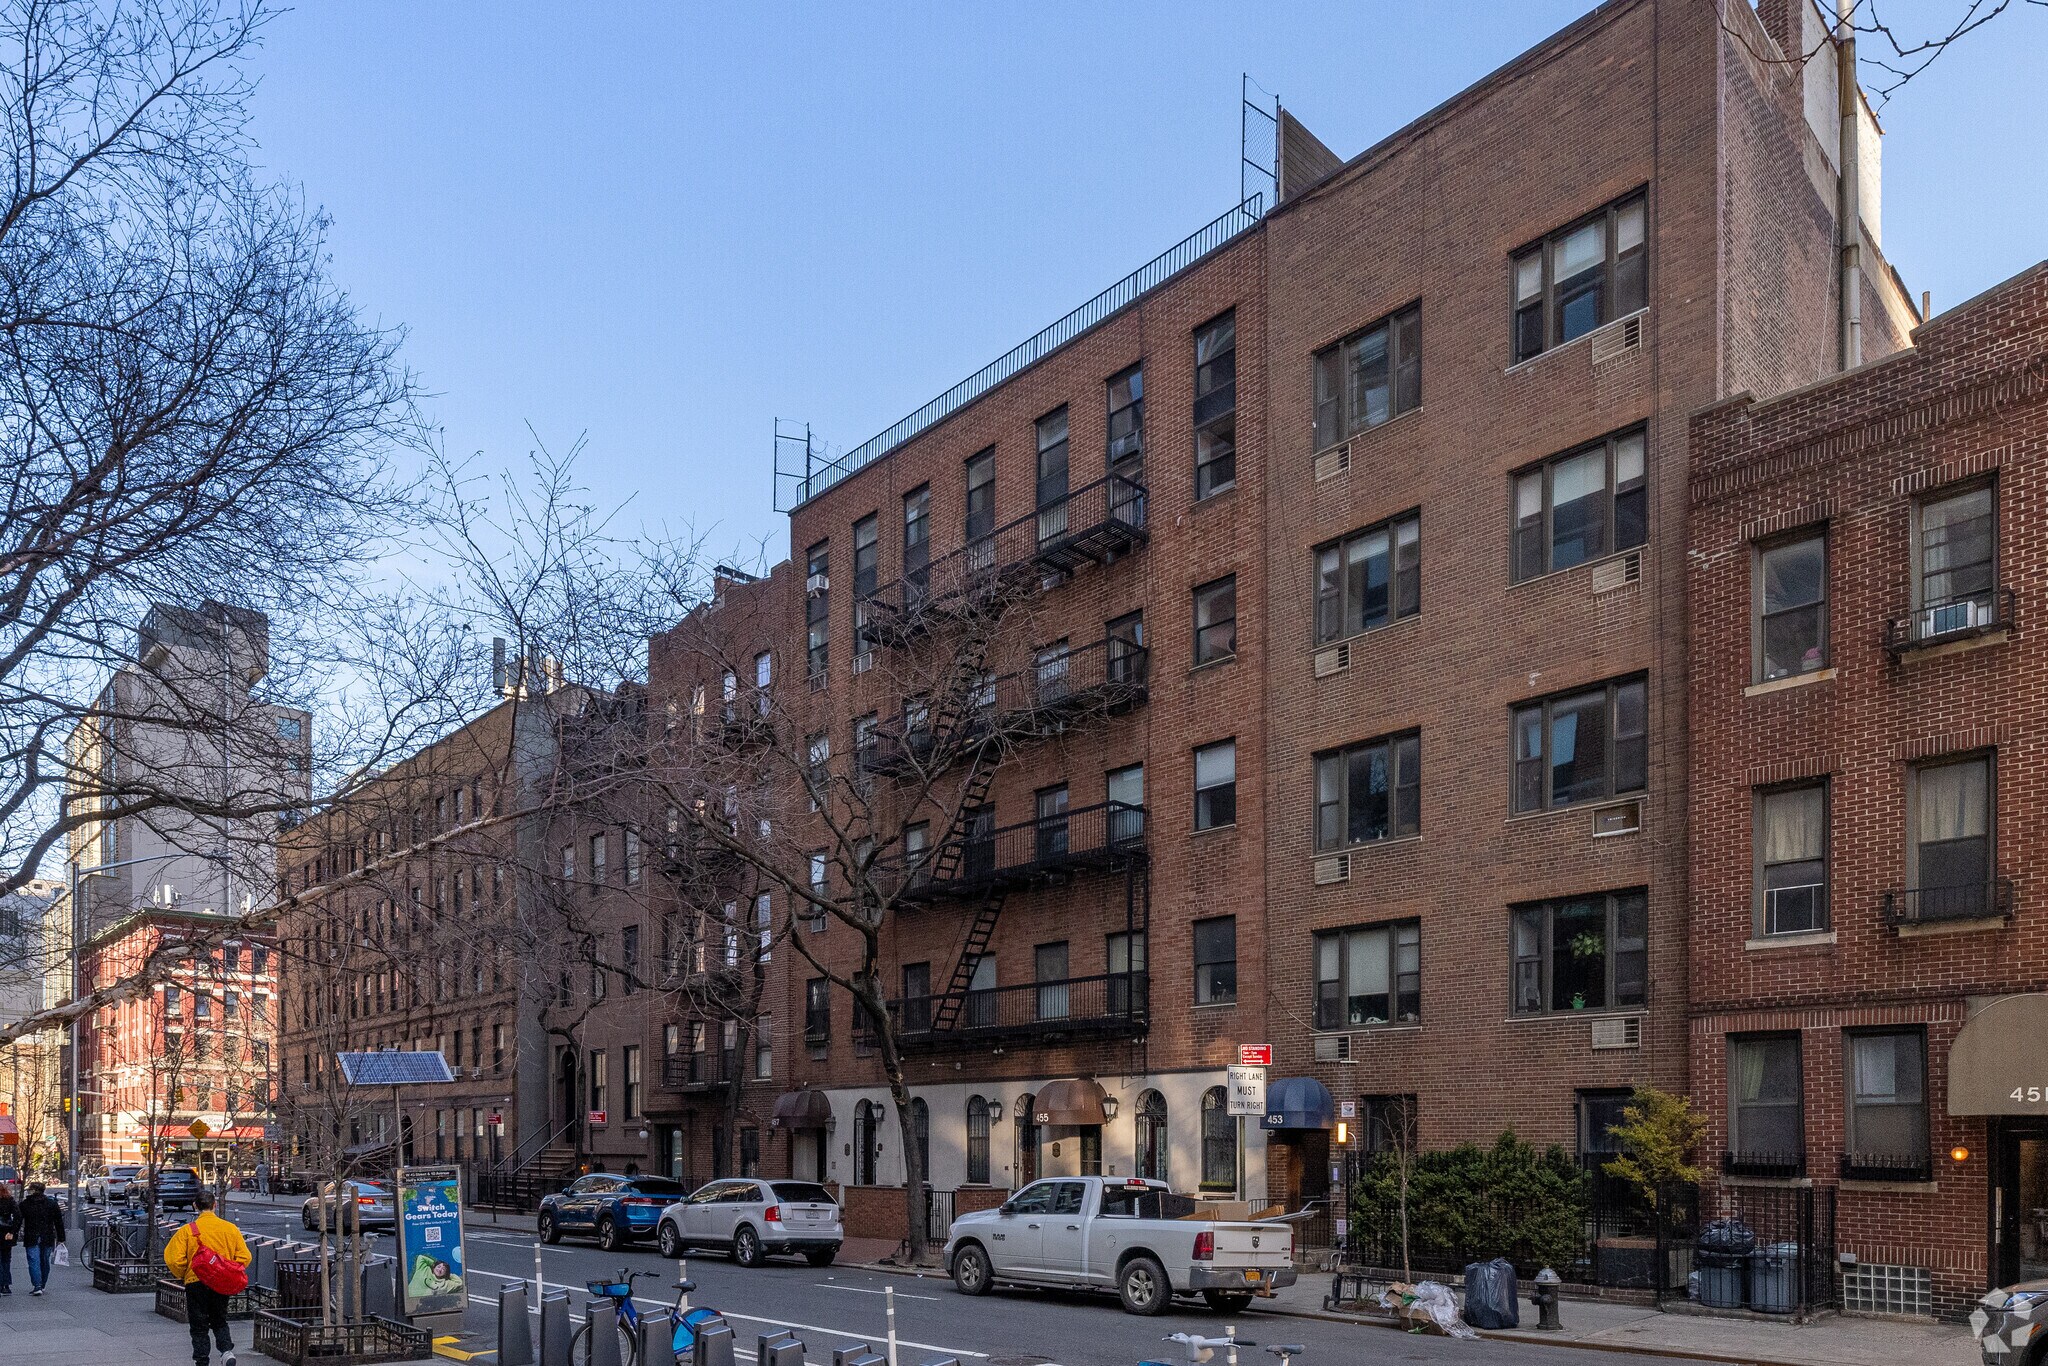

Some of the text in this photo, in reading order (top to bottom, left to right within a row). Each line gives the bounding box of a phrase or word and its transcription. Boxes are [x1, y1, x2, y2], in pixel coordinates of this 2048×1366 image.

[1230, 1072, 1246, 1080] RIGHT
[1237, 1086, 1256, 1095] MUST
[2010, 1086, 2048, 1102] 45
[1230, 1101, 1263, 1110] TURN RIGHT
[1036, 1113, 1049, 1122] 455
[1268, 1115, 1283, 1124] 453
